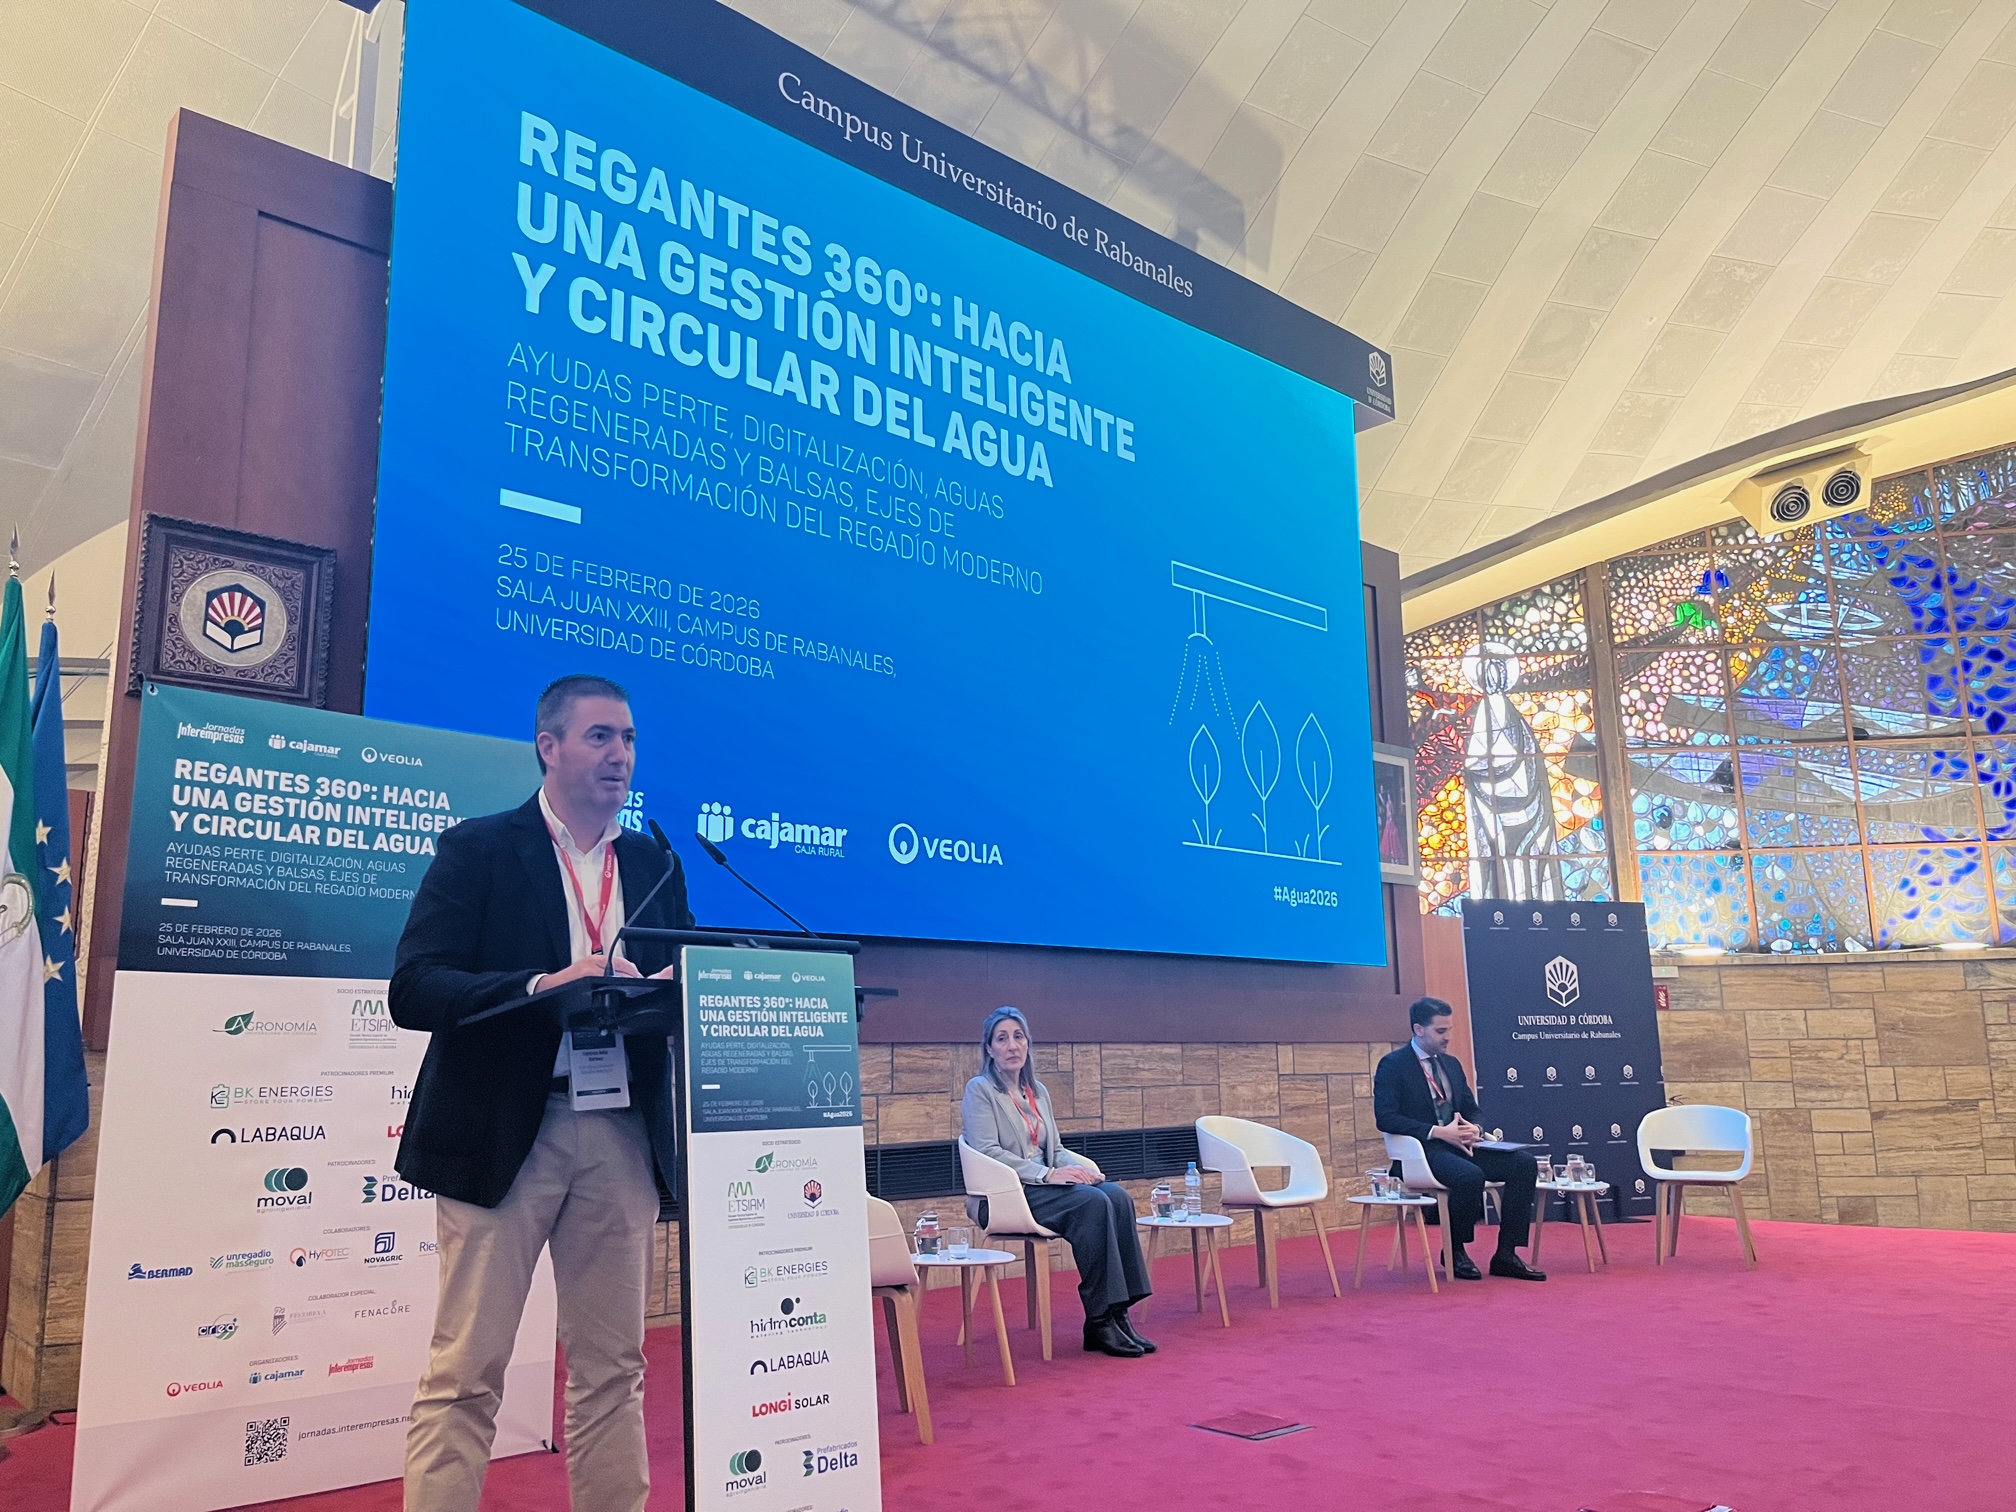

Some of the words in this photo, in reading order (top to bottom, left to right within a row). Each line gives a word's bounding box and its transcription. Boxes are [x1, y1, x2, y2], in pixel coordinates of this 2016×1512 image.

[778, 72, 893, 150] Campus
[901, 132, 1057, 231] Universitario
[1063, 217, 1088, 247] de
[1094, 228, 1193, 298] Rabanales
[521, 110, 812, 276] REGANTES
[955, 296, 1072, 385] HACIA
[517, 182, 646, 281] UNA
[660, 240, 877, 366] GESTIÓN
[889, 328, 1136, 462] INTELIGENTE
[511, 251, 556, 315] Y
[568, 277, 841, 416] CIRCULAR
[853, 375, 937, 448] DEL
[942, 410, 1054, 488] AGUA
[507, 342, 632, 404] AYUDAS
[643, 382, 735, 440] PERTE,
[744, 415, 930, 499] DIGITALIZACIÓN,
[935, 478, 1005, 520] AGUAS
[507, 381, 726, 472] REGENERADAS
[734, 450, 751, 478] Y
[760, 457, 859, 514] BALSAS,
[867, 487, 920, 528] EJES
[929, 507, 956, 539] DE
[504, 421, 778, 524] TRANSFORMACIÓN
[787, 501, 831, 539] DEL
[840, 516, 936, 567] REGADÍO
[944, 546, 1043, 595] MODERNO
[498, 544, 528, 569] 25
[535, 552, 565, 577] DE
[572, 561, 672, 601] FEBRERO
[679, 582, 705, 608] DE
[709, 590, 761, 619] 2026
[497, 575, 556, 607] SALA
[560, 590, 621, 621] JUAN
[626, 604, 673, 634] XXIII,
[677, 614, 761, 649] CAMPUS
[766, 632, 790, 652] DE
[793, 637, 897, 679] RABANALES,
[496, 608, 644, 654] UNIVERSIDAD
[651, 638, 676, 662] DE
[681, 639, 775, 681] CÓRDOBA
[178, 722, 245, 744] Interempresas
[203, 722, 245, 735] Jornadas
[289, 739, 341, 755] cajamar
[379, 752, 423, 767] VEOLIA
[175, 758, 310, 794] REGANTES
[383, 785, 451, 810] HACIA
[172, 784, 229, 810] UNA
[234, 791, 341, 822] GESTIÓN
[346, 805, 466, 834] INTELIGEN
[170, 810, 189, 832] Y
[193, 813, 320, 845] CIRCULAR
[326, 827, 369, 850] DEL
[373, 832, 436, 856] AGUA
[741, 812, 847, 849] cajamar
[166, 842, 221, 857] AYUDAS
[224, 847, 267, 863] PERTE,
[271, 850, 364, 871] DIGITALIZACIÓN,
[367, 860, 406, 873] AGUAS
[795, 844, 816, 856] CAJA
[818, 847, 845, 858] RURAL
[923, 837, 1004, 865] VEOLIA
[166, 856, 262, 876] REGENERADAS
[265, 865, 274, 875] Y
[277, 866, 328, 881] BALSAS,
[330, 870, 362, 884] EJES
[365, 873, 377, 884] DE
[164, 870, 285, 891] TRANSFORMACIÓN
[289, 879, 311, 893] DEL
[315, 882, 366, 898] REGADÍO
[368, 887, 415, 900] MODERN
[1273, 886, 1338, 907] #Agua2026
[159, 922, 173, 933] 25
[175, 923, 189, 933] DE
[192, 924, 239, 936] FEBRERO
[242, 926, 254, 937] DE
[256, 927, 282, 938] 2026
[158, 934, 184, 944] SALA
[187, 935, 214, 946] JUAN
[216, 937, 238, 948] XXIII,
[240, 938, 281, 949] CAMPUS
[283, 941, 295, 950] DE
[157, 946, 225, 958] UNIVERSIDAD
[227, 949, 240, 959] DE
[242, 948, 287, 960] CÓRDOBA
[754, 971, 781, 980] cajamar
[700, 995, 761, 1008] REGANTES
[795, 998, 828, 1009] HACIA
[231, 1016, 318, 1032] AGRONOMÍA
[700, 1010, 726, 1022] UNA
[727, 1008, 777, 1023] GESTIÓN
[780, 1011, 848, 1024] INTELIGENTE
[1518, 1015, 1567, 1026] UNIVERSIDAD
[1578, 1012, 1613, 1025] CÓRDOBA
[351, 1018, 398, 1032] ETSIAM
[700, 1025, 709, 1037] Y
[711, 1024, 769, 1037] CIRCULAR
[771, 1025, 792, 1037] DEL
[794, 1025, 824, 1038] AGUA
[1512, 1031, 1539, 1041] Campus
[1539, 1031, 1580, 1039] Universitario
[1590, 1031, 1621, 1039] Rabanales
[701, 1066, 728, 1074] REGADÍO
[729, 1066, 759, 1074] MODERNO
[717, 1058, 726, 1066] DE
[234, 1087, 254, 1098] BK
[258, 1085, 334, 1098] ENERGIES
[823, 1111, 853, 1120] #Agua2026
[240, 1125, 326, 1143] LABAQUA
[760, 1156, 818, 1169] AGRONOMÍA
[257, 1192, 312, 1207] moval
[728, 1198, 765, 1213] ETSIAM
[227, 1249, 272, 1261] unregadío
[309, 1247, 350, 1260] HyFOTEC
[364, 1254, 404, 1264] NOVAGRIC
[148, 1266, 193, 1279] BERMAD
[760, 1268, 773, 1278] BK
[777, 1261, 828, 1276] ENERGIES
[354, 1300, 411, 1319] FENACORE
[198, 1323, 236, 1337] crea
[751, 1312, 827, 1333] hidroconta
[346, 1355, 374, 1364] Jornadas
[770, 1350, 829, 1372] LABAQUA
[264, 1368, 305, 1382] cajamar
[328, 1360, 374, 1377] Interempresas
[183, 1381, 223, 1392] VEOLIA
[795, 1394, 829, 1409] SOLAR
[298, 1415, 412, 1442] jornadas.interempresas.ne
[817, 1441, 858, 1454] Prefabricados
[817, 1452, 858, 1474] Delta
[726, 1471, 766, 1492] moval
